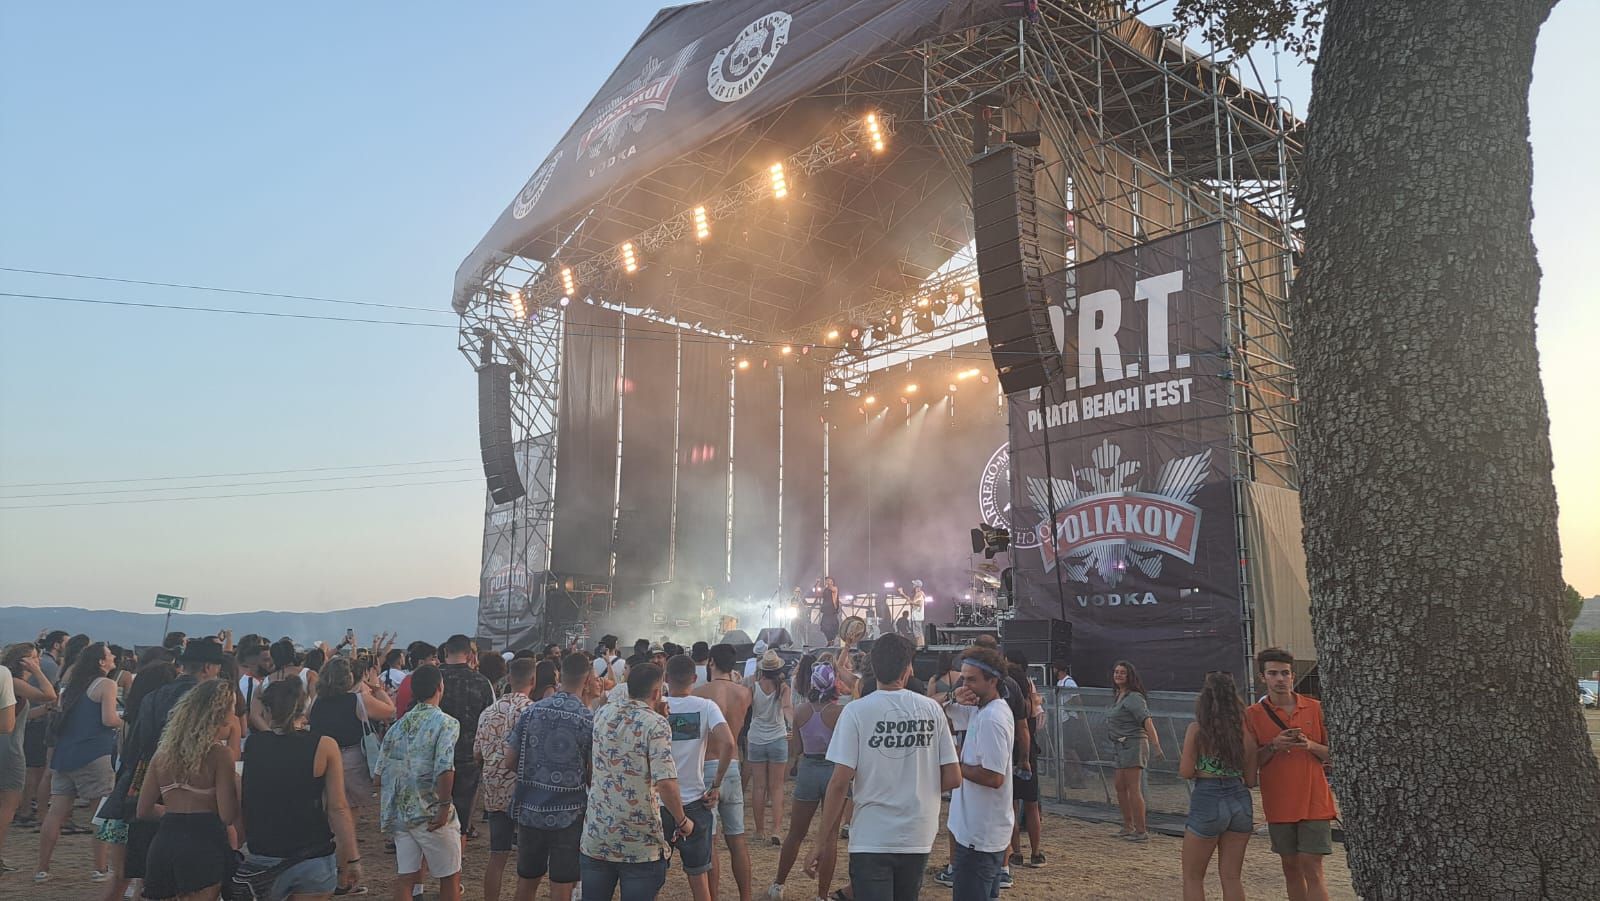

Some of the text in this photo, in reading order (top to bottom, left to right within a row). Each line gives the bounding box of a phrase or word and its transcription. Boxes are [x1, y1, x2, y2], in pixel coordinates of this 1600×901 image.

[1082, 386, 1140, 420] BEACH
[1144, 377, 1193, 409] FEST
[1054, 503, 1183, 552] POLIAKOV
[1076, 592, 1158, 608] VODKA
[875, 720, 935, 734] SPORTS
